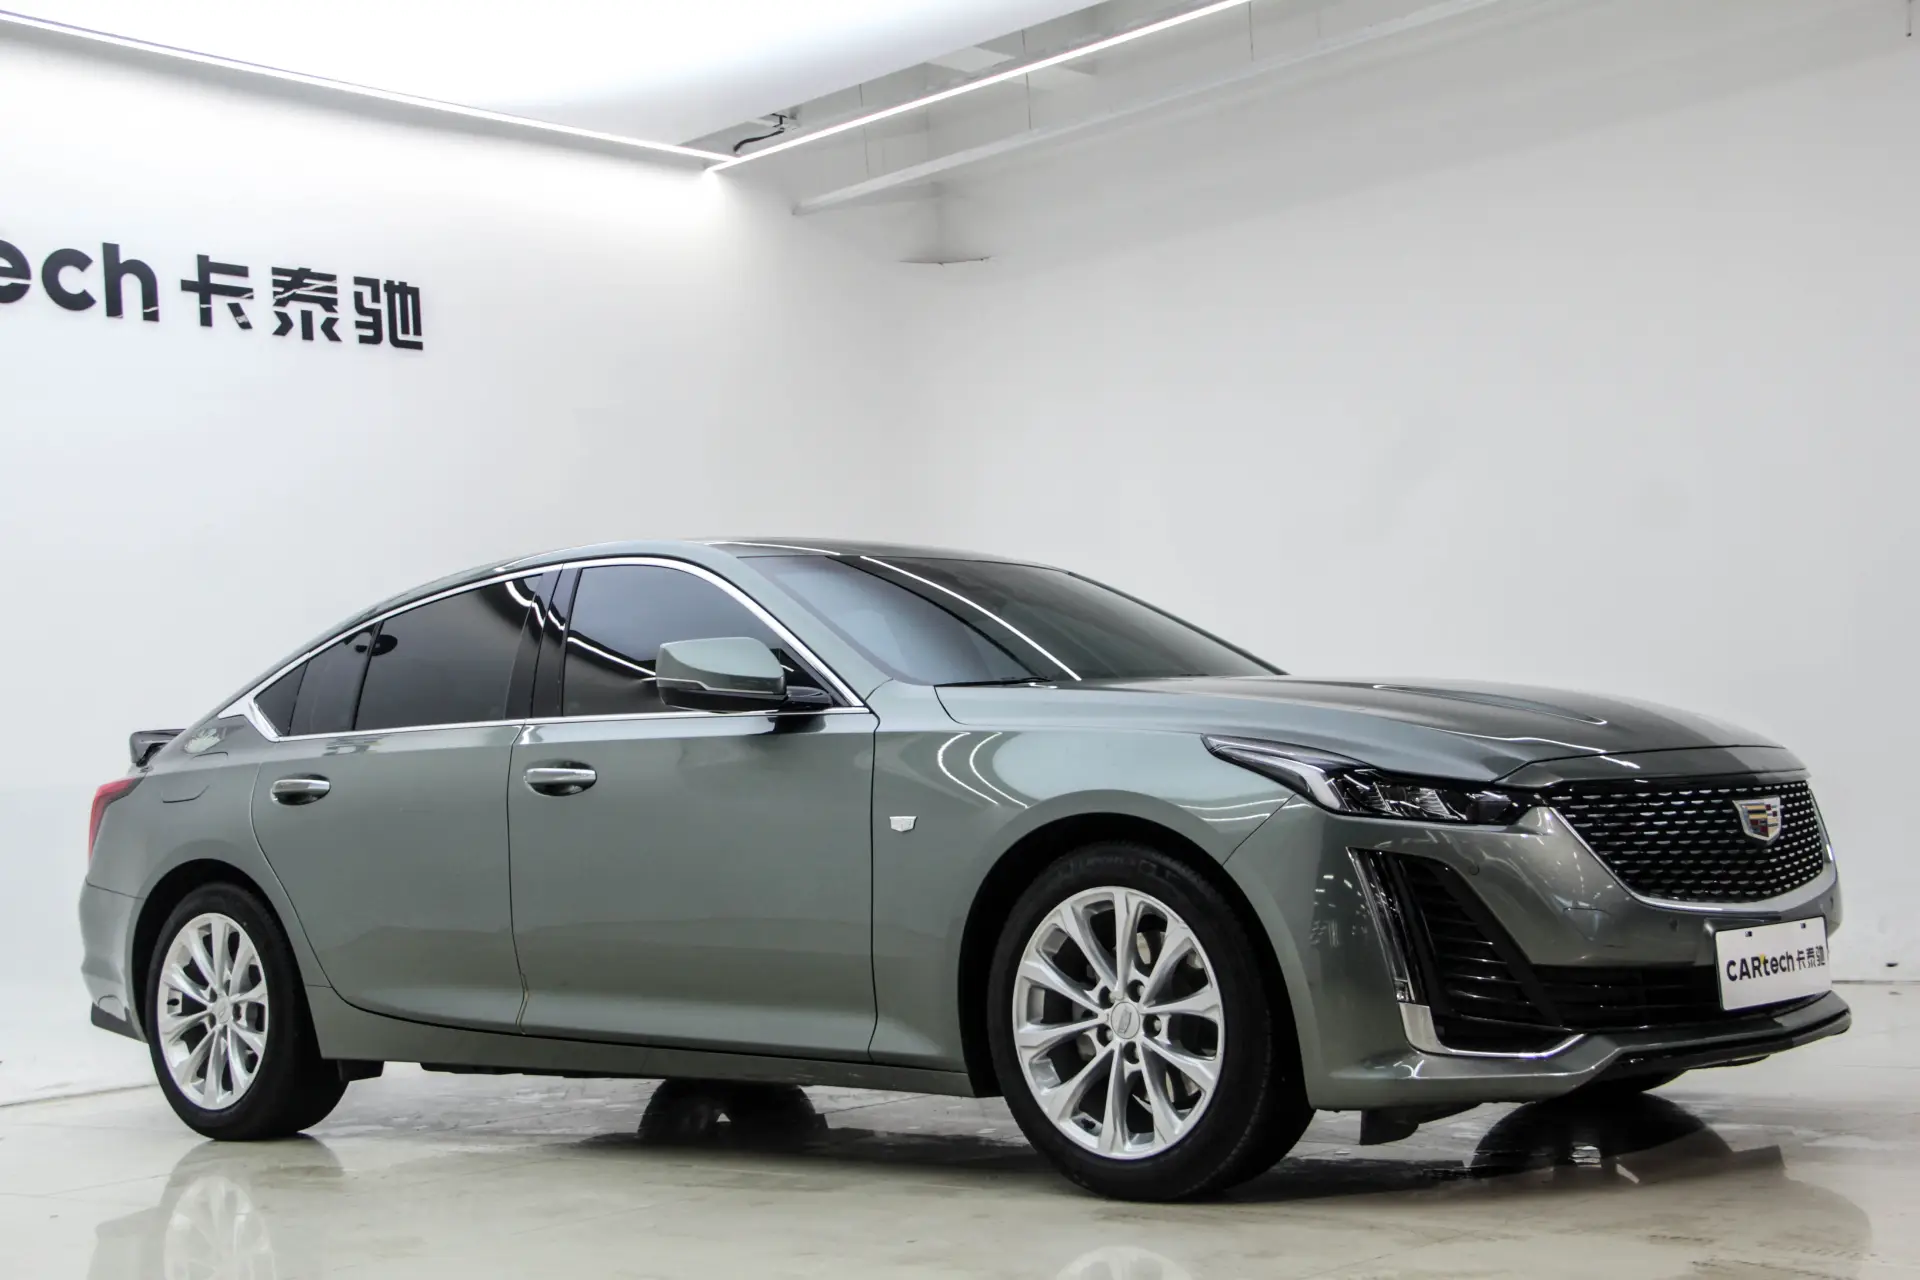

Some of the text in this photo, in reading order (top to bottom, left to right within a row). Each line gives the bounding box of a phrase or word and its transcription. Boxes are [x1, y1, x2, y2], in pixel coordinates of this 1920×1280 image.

[180, 254, 424, 351] 卡泰驰
[1726, 945, 1826, 982] CARtech 卡泰驰
